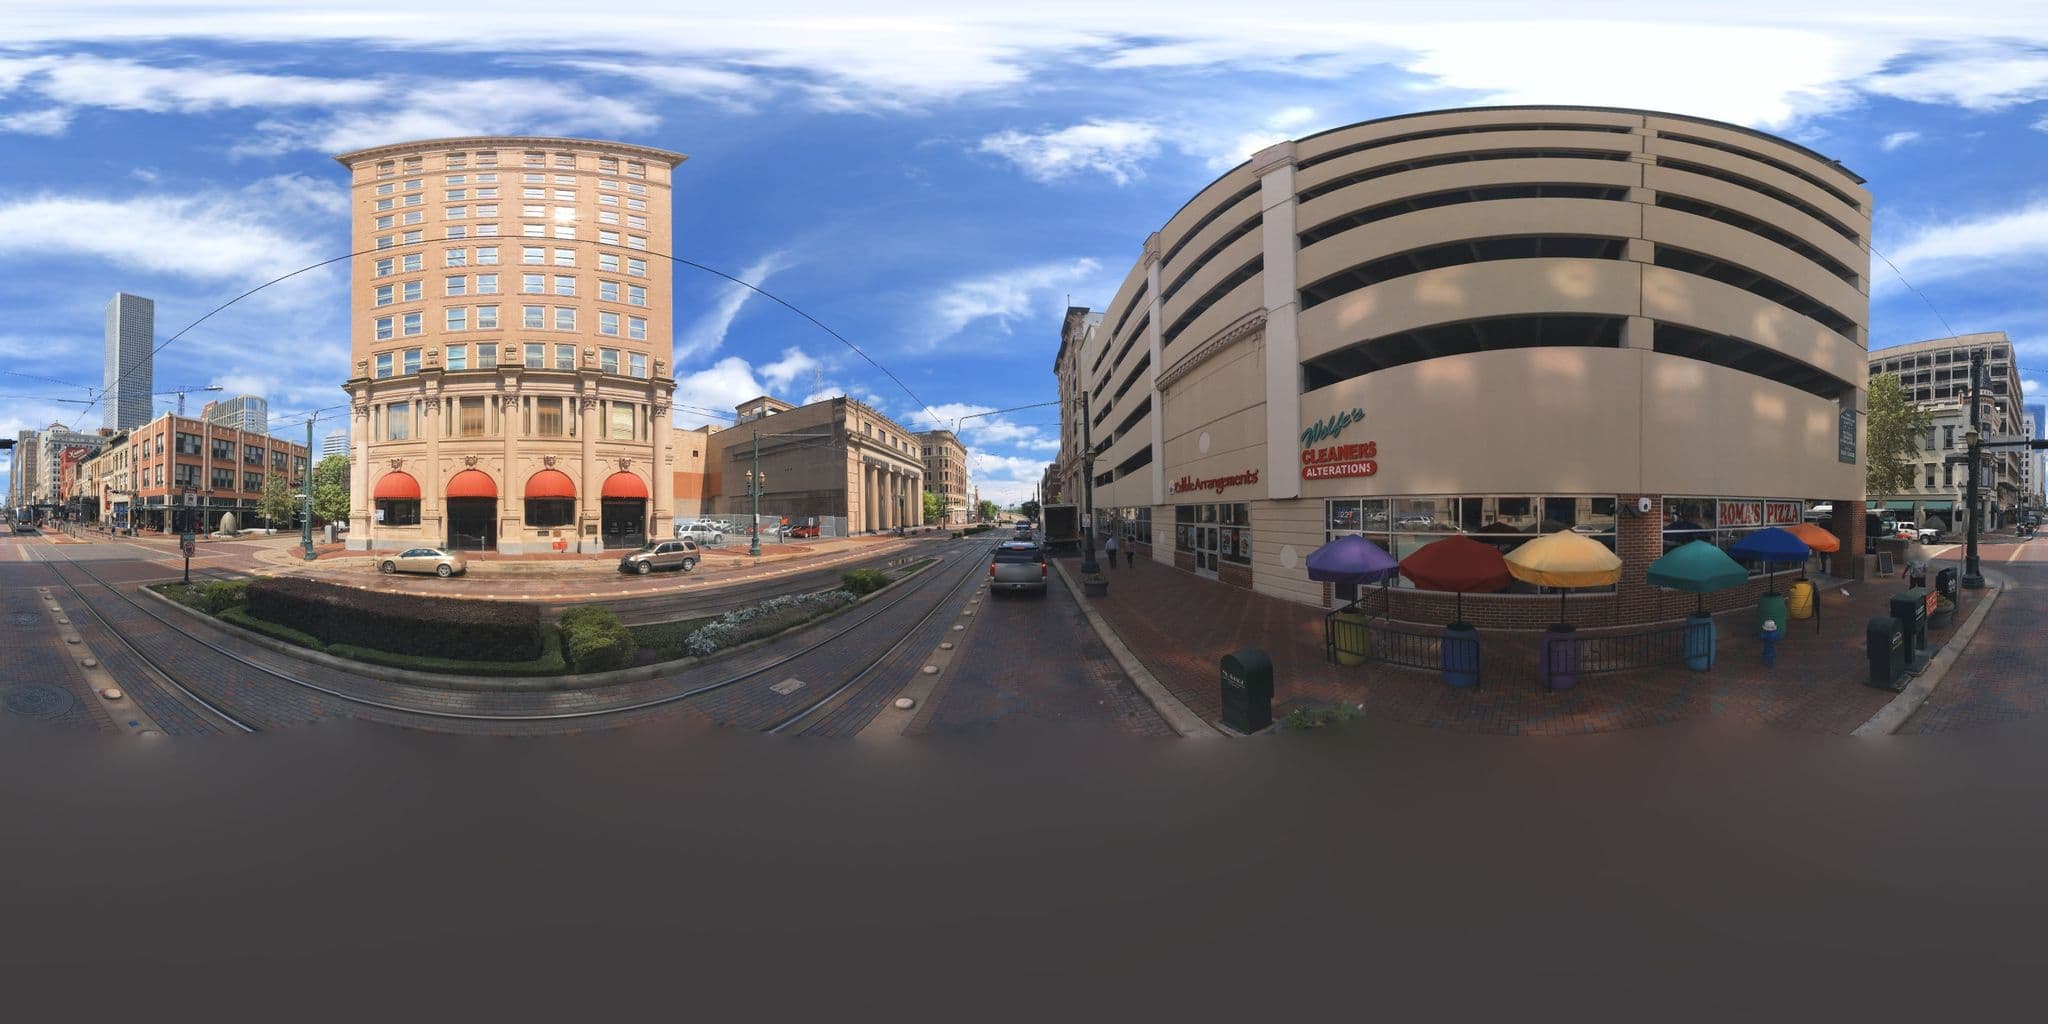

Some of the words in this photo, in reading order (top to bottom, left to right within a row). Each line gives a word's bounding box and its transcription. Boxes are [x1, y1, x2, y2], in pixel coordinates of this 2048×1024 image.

[1301, 407, 1366, 448] Wolfe's
[1301, 440, 1377, 465] CLEANERS
[1306, 462, 1371, 478] ALTERATIONS
[1719, 502, 1760, 525] ROMA'S
[1766, 503, 1799, 523] PIZZA
